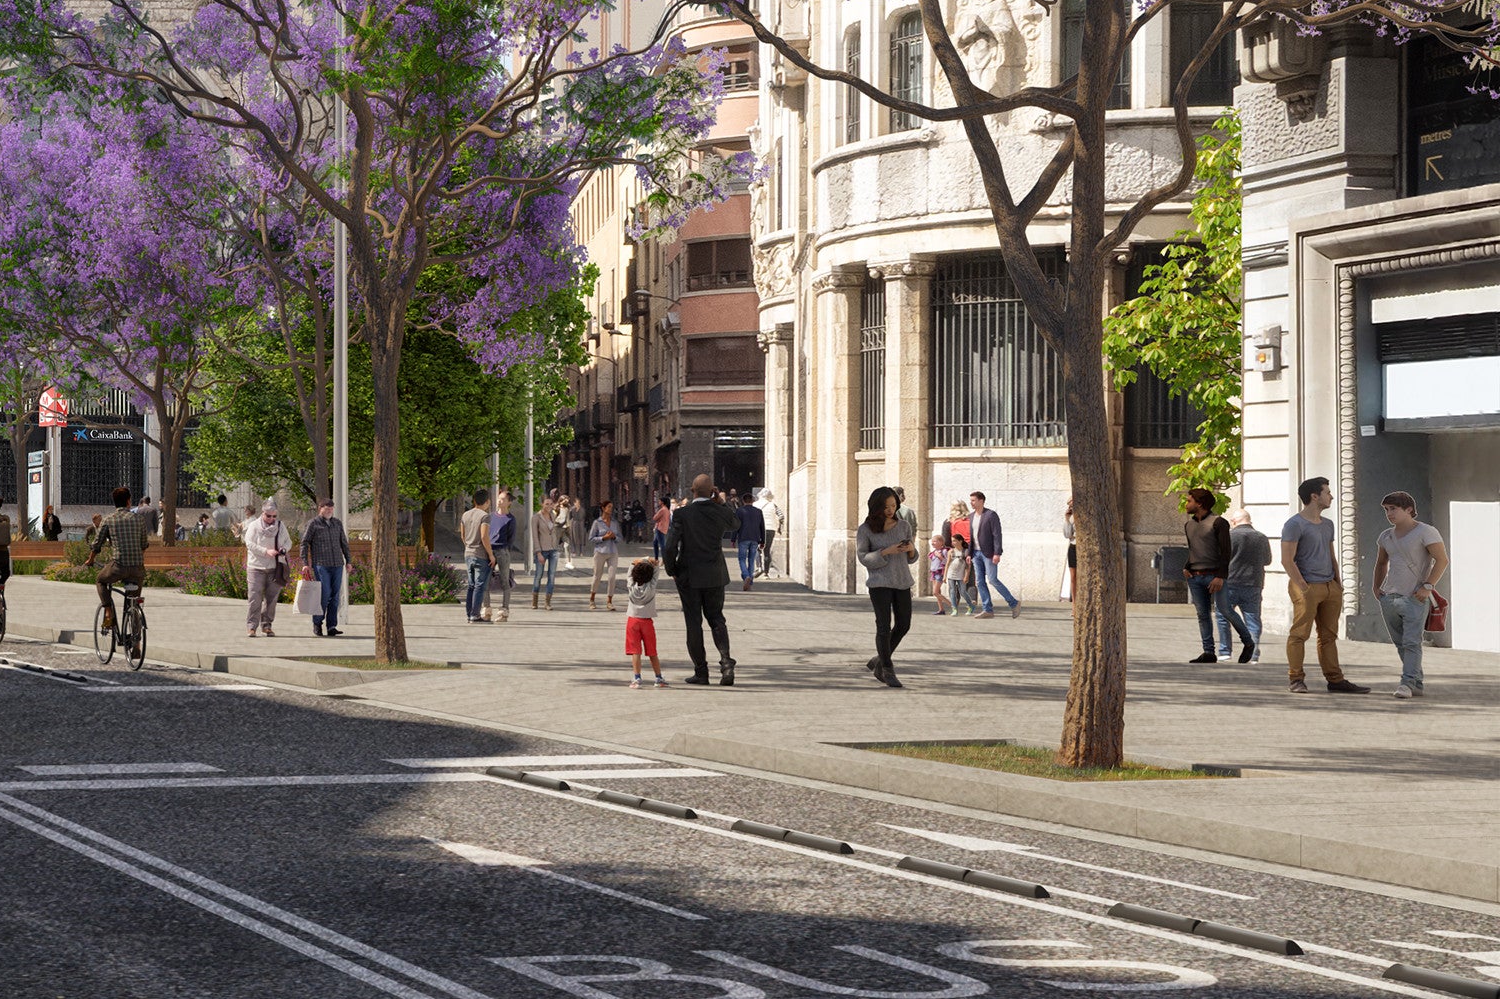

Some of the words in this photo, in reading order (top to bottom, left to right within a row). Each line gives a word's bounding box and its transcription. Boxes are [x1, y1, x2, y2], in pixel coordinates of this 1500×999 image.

[1420, 128, 1452, 145] metres
[90, 429, 133, 440] CaixaBank
[484, 940, 1217, 999] BUS
